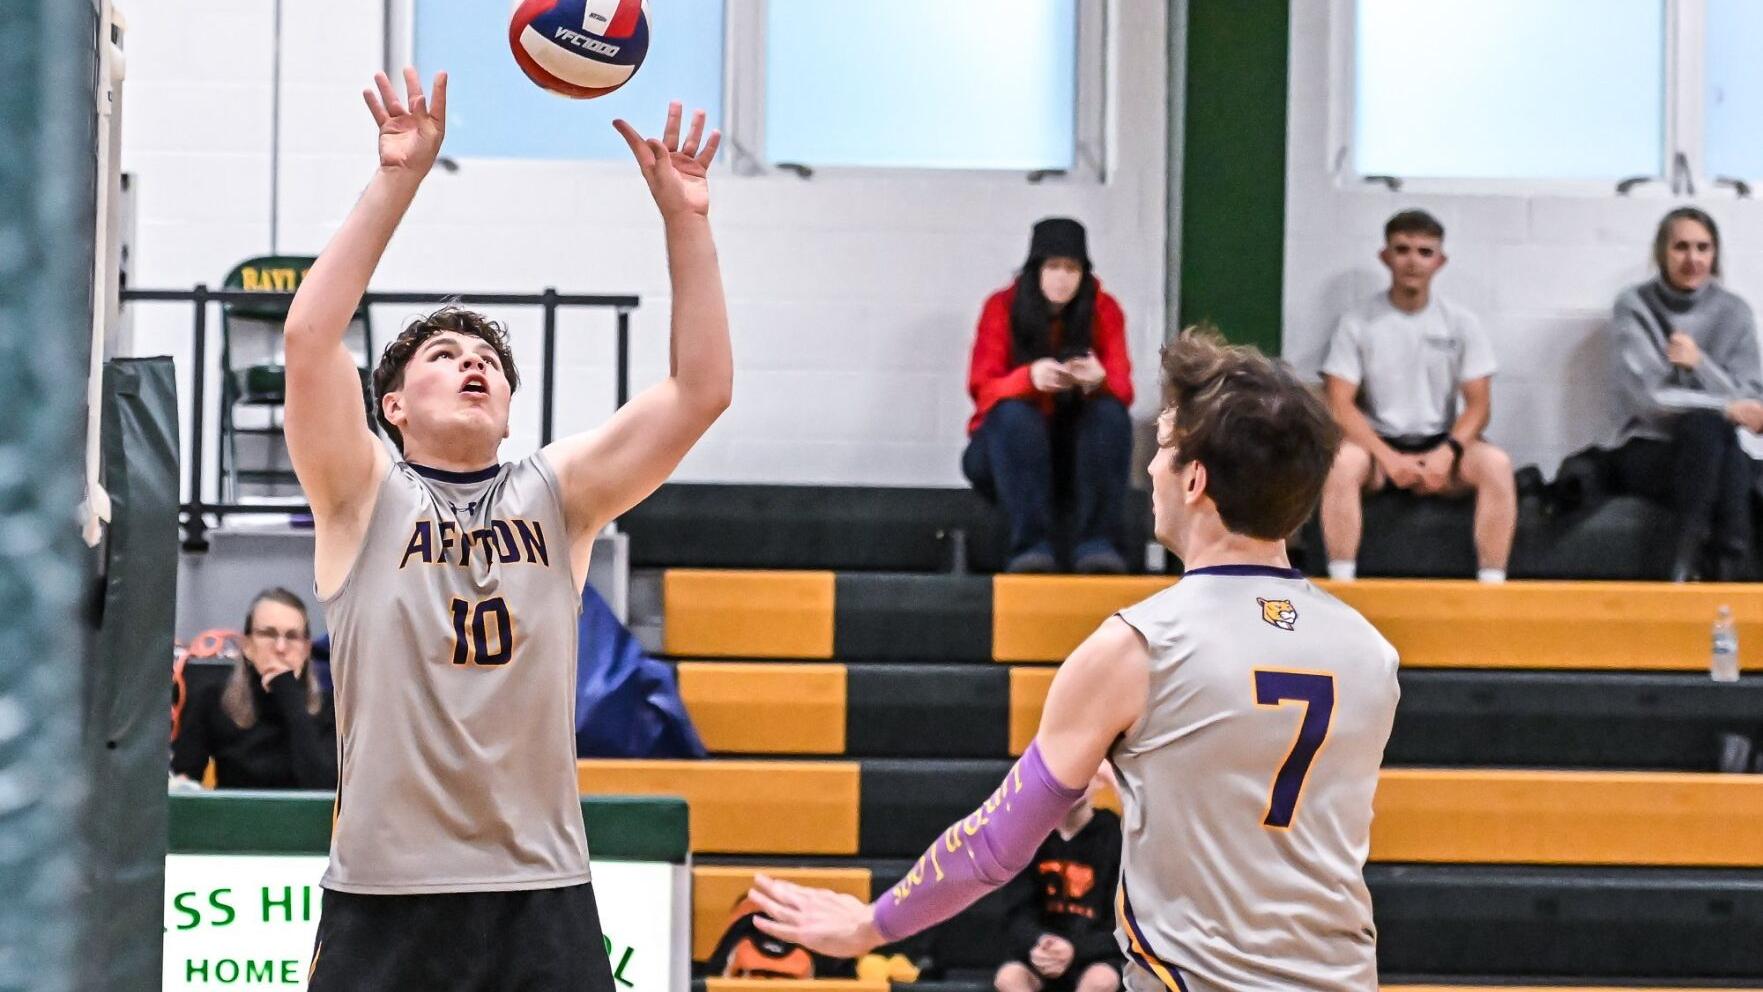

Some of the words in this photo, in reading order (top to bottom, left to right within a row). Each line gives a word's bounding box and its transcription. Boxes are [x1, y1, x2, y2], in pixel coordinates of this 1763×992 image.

[554, 26, 620, 57] VFC1000
[241, 266, 308, 291] BAYL
[450, 595, 514, 668] 10
[1252, 668, 1337, 831] 7
[165, 888, 236, 933] SS
[262, 885, 322, 922] HI
[186, 958, 299, 984] HOME
